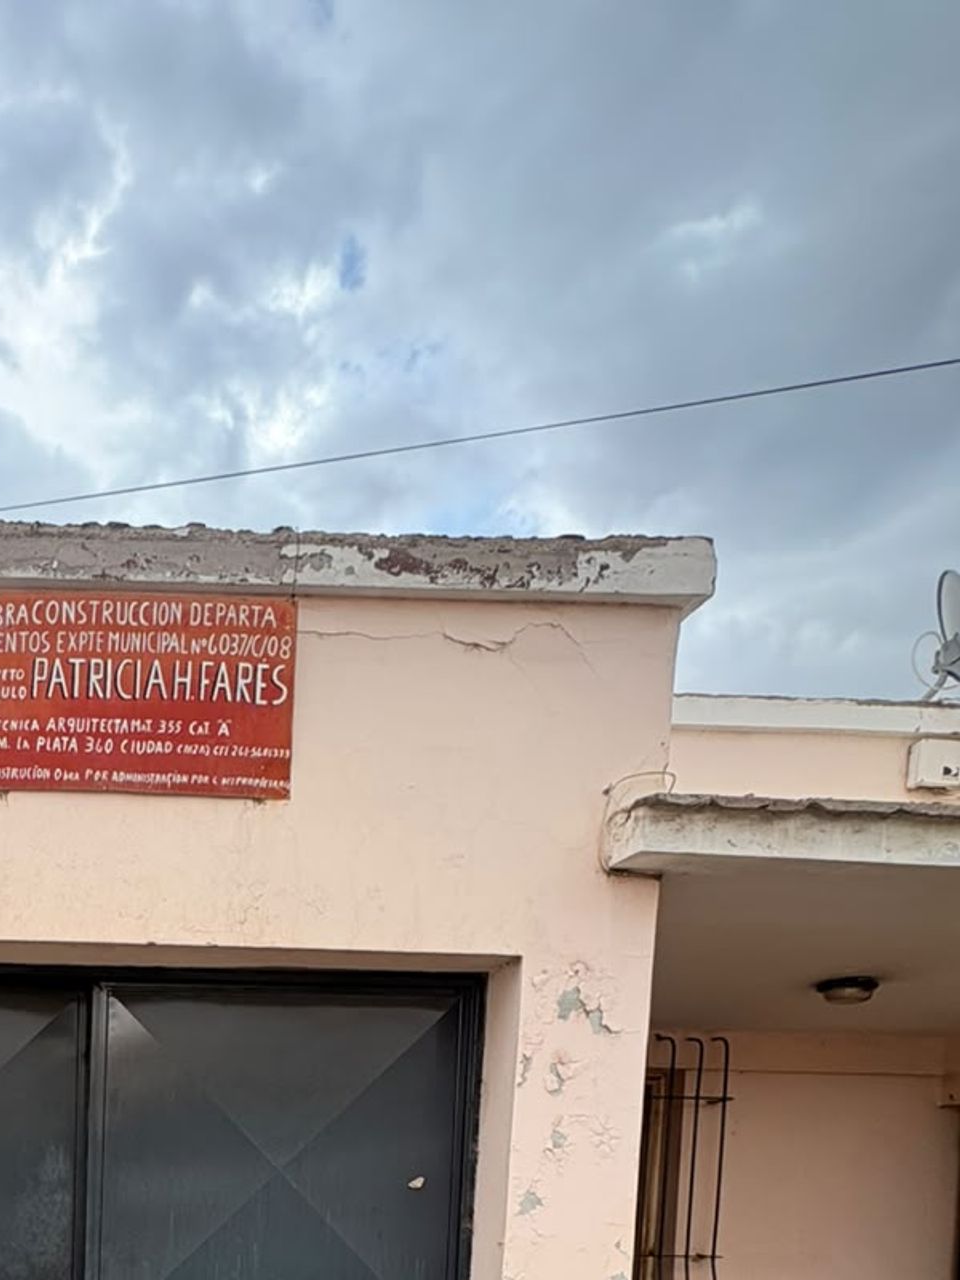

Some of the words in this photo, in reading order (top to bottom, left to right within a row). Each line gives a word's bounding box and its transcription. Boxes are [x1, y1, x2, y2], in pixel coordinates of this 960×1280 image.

[31, 600, 182, 626] CONSTRUCCION
[189, 602, 277, 629] DEPARTA
[56, 631, 104, 653] EXPTE
[108, 631, 188, 654] MUNICIPAL
[32, 658, 167, 700] PATRICIA
[46, 717, 130, 734] ARQUITECTA
[157, 720, 182, 734] 355
[36, 736, 78, 753] PLATA
[84, 736, 114, 754] 360
[120, 739, 174, 755] CIUDAD
